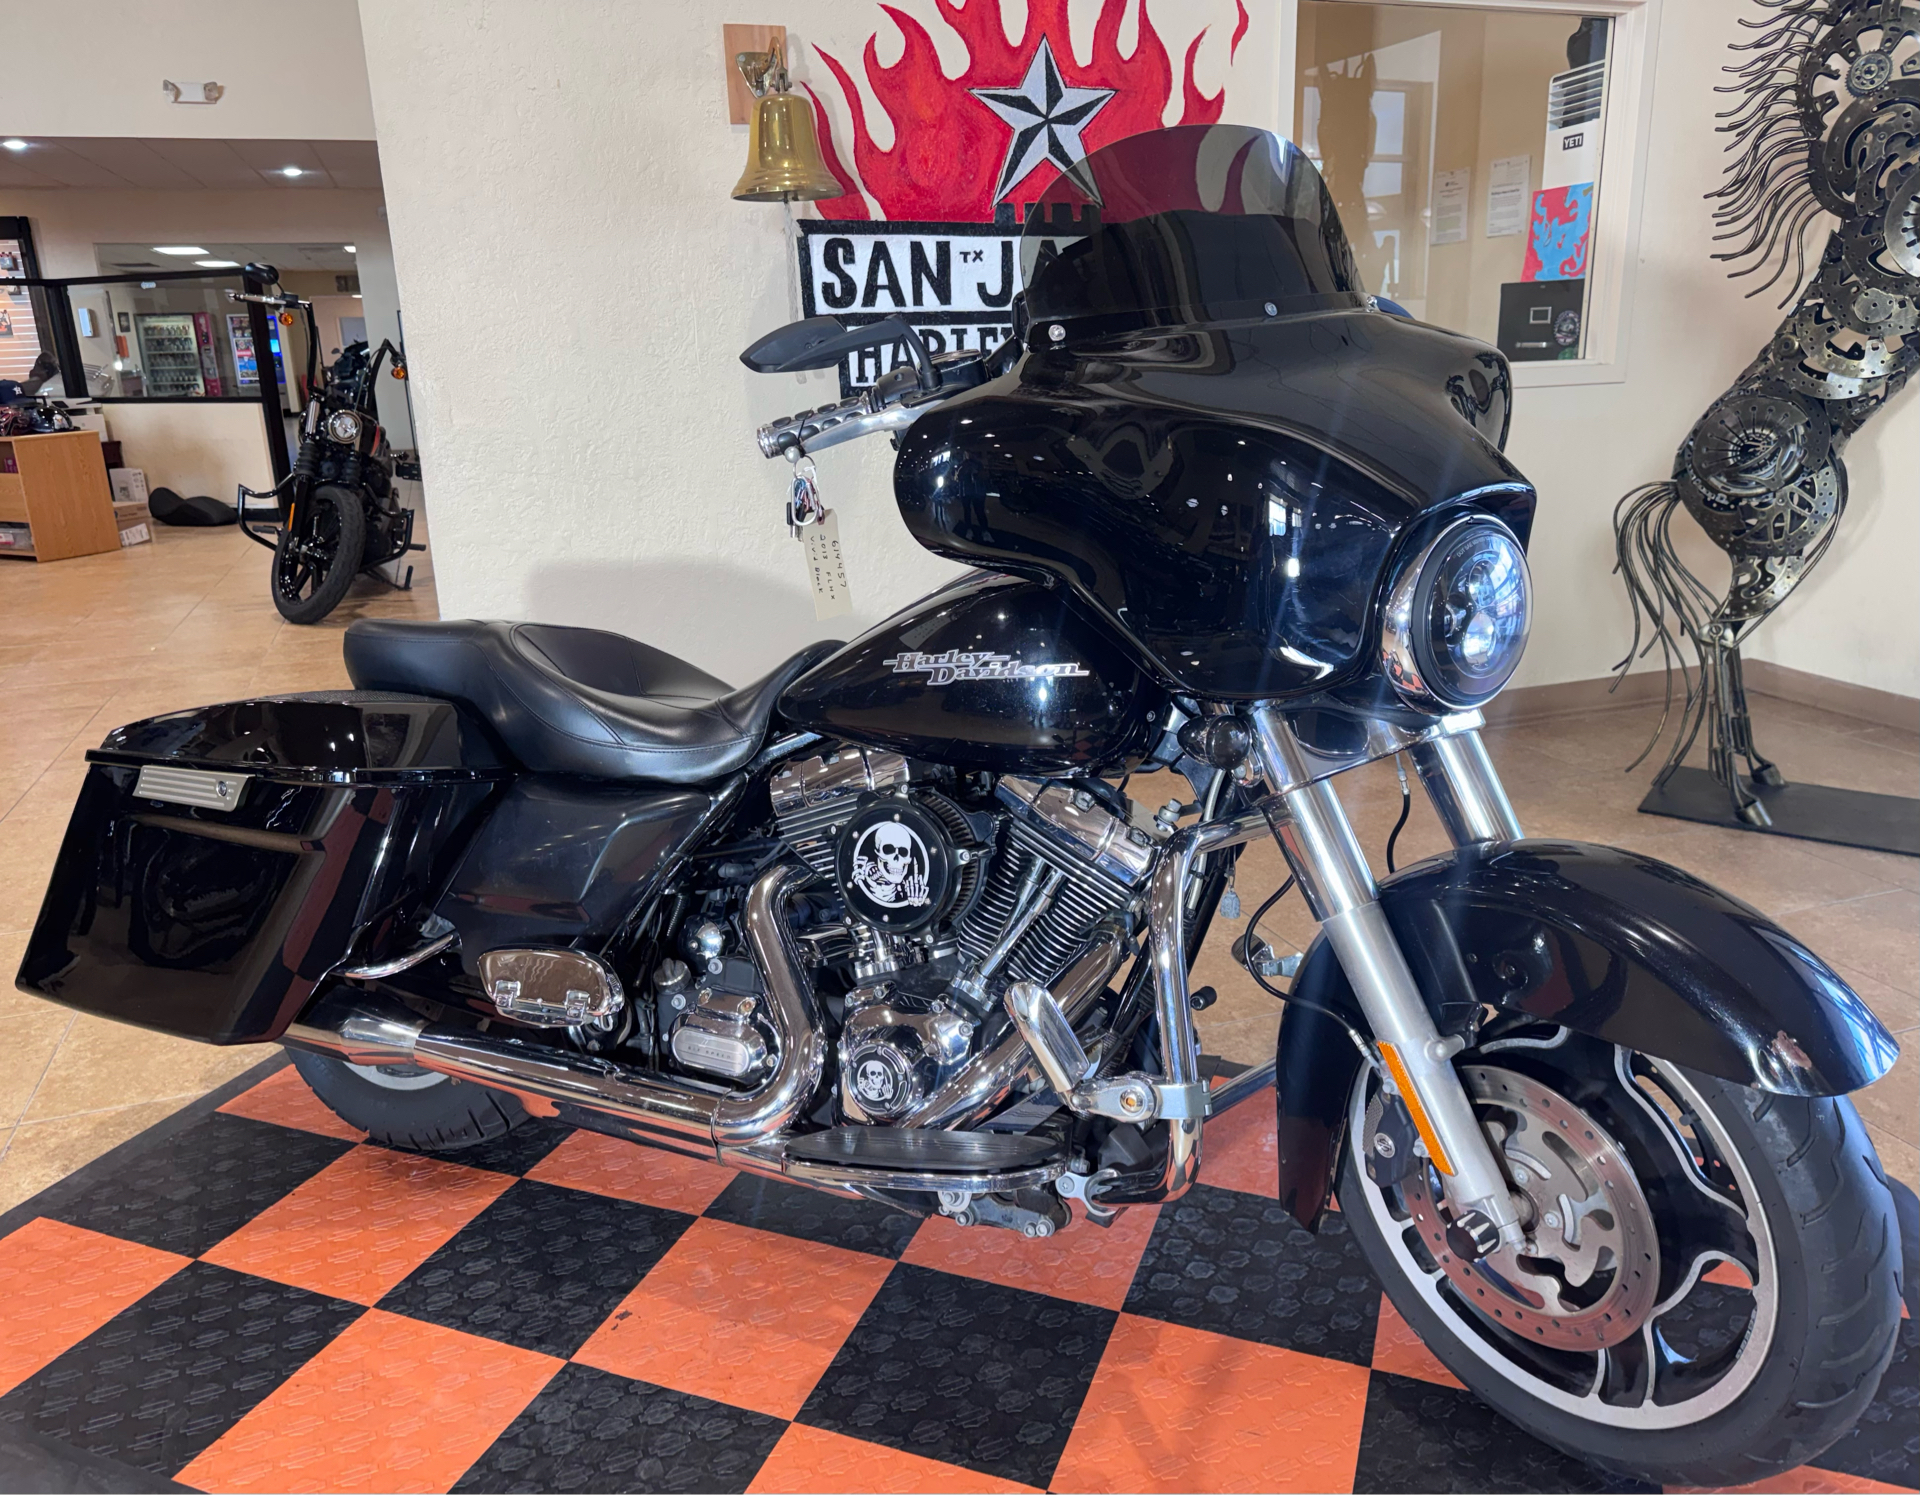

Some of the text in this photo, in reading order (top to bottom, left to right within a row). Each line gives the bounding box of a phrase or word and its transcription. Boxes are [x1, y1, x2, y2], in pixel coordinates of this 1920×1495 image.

[1564, 135, 1582, 149] YETI
[821, 238, 952, 309] SAN
[959, 249, 984, 263] TX
[831, 540, 847, 588] 614457
[826, 571, 836, 600] FLHX
[883, 649, 1011, 673] Harley
[927, 660, 1090, 685] Davidson
